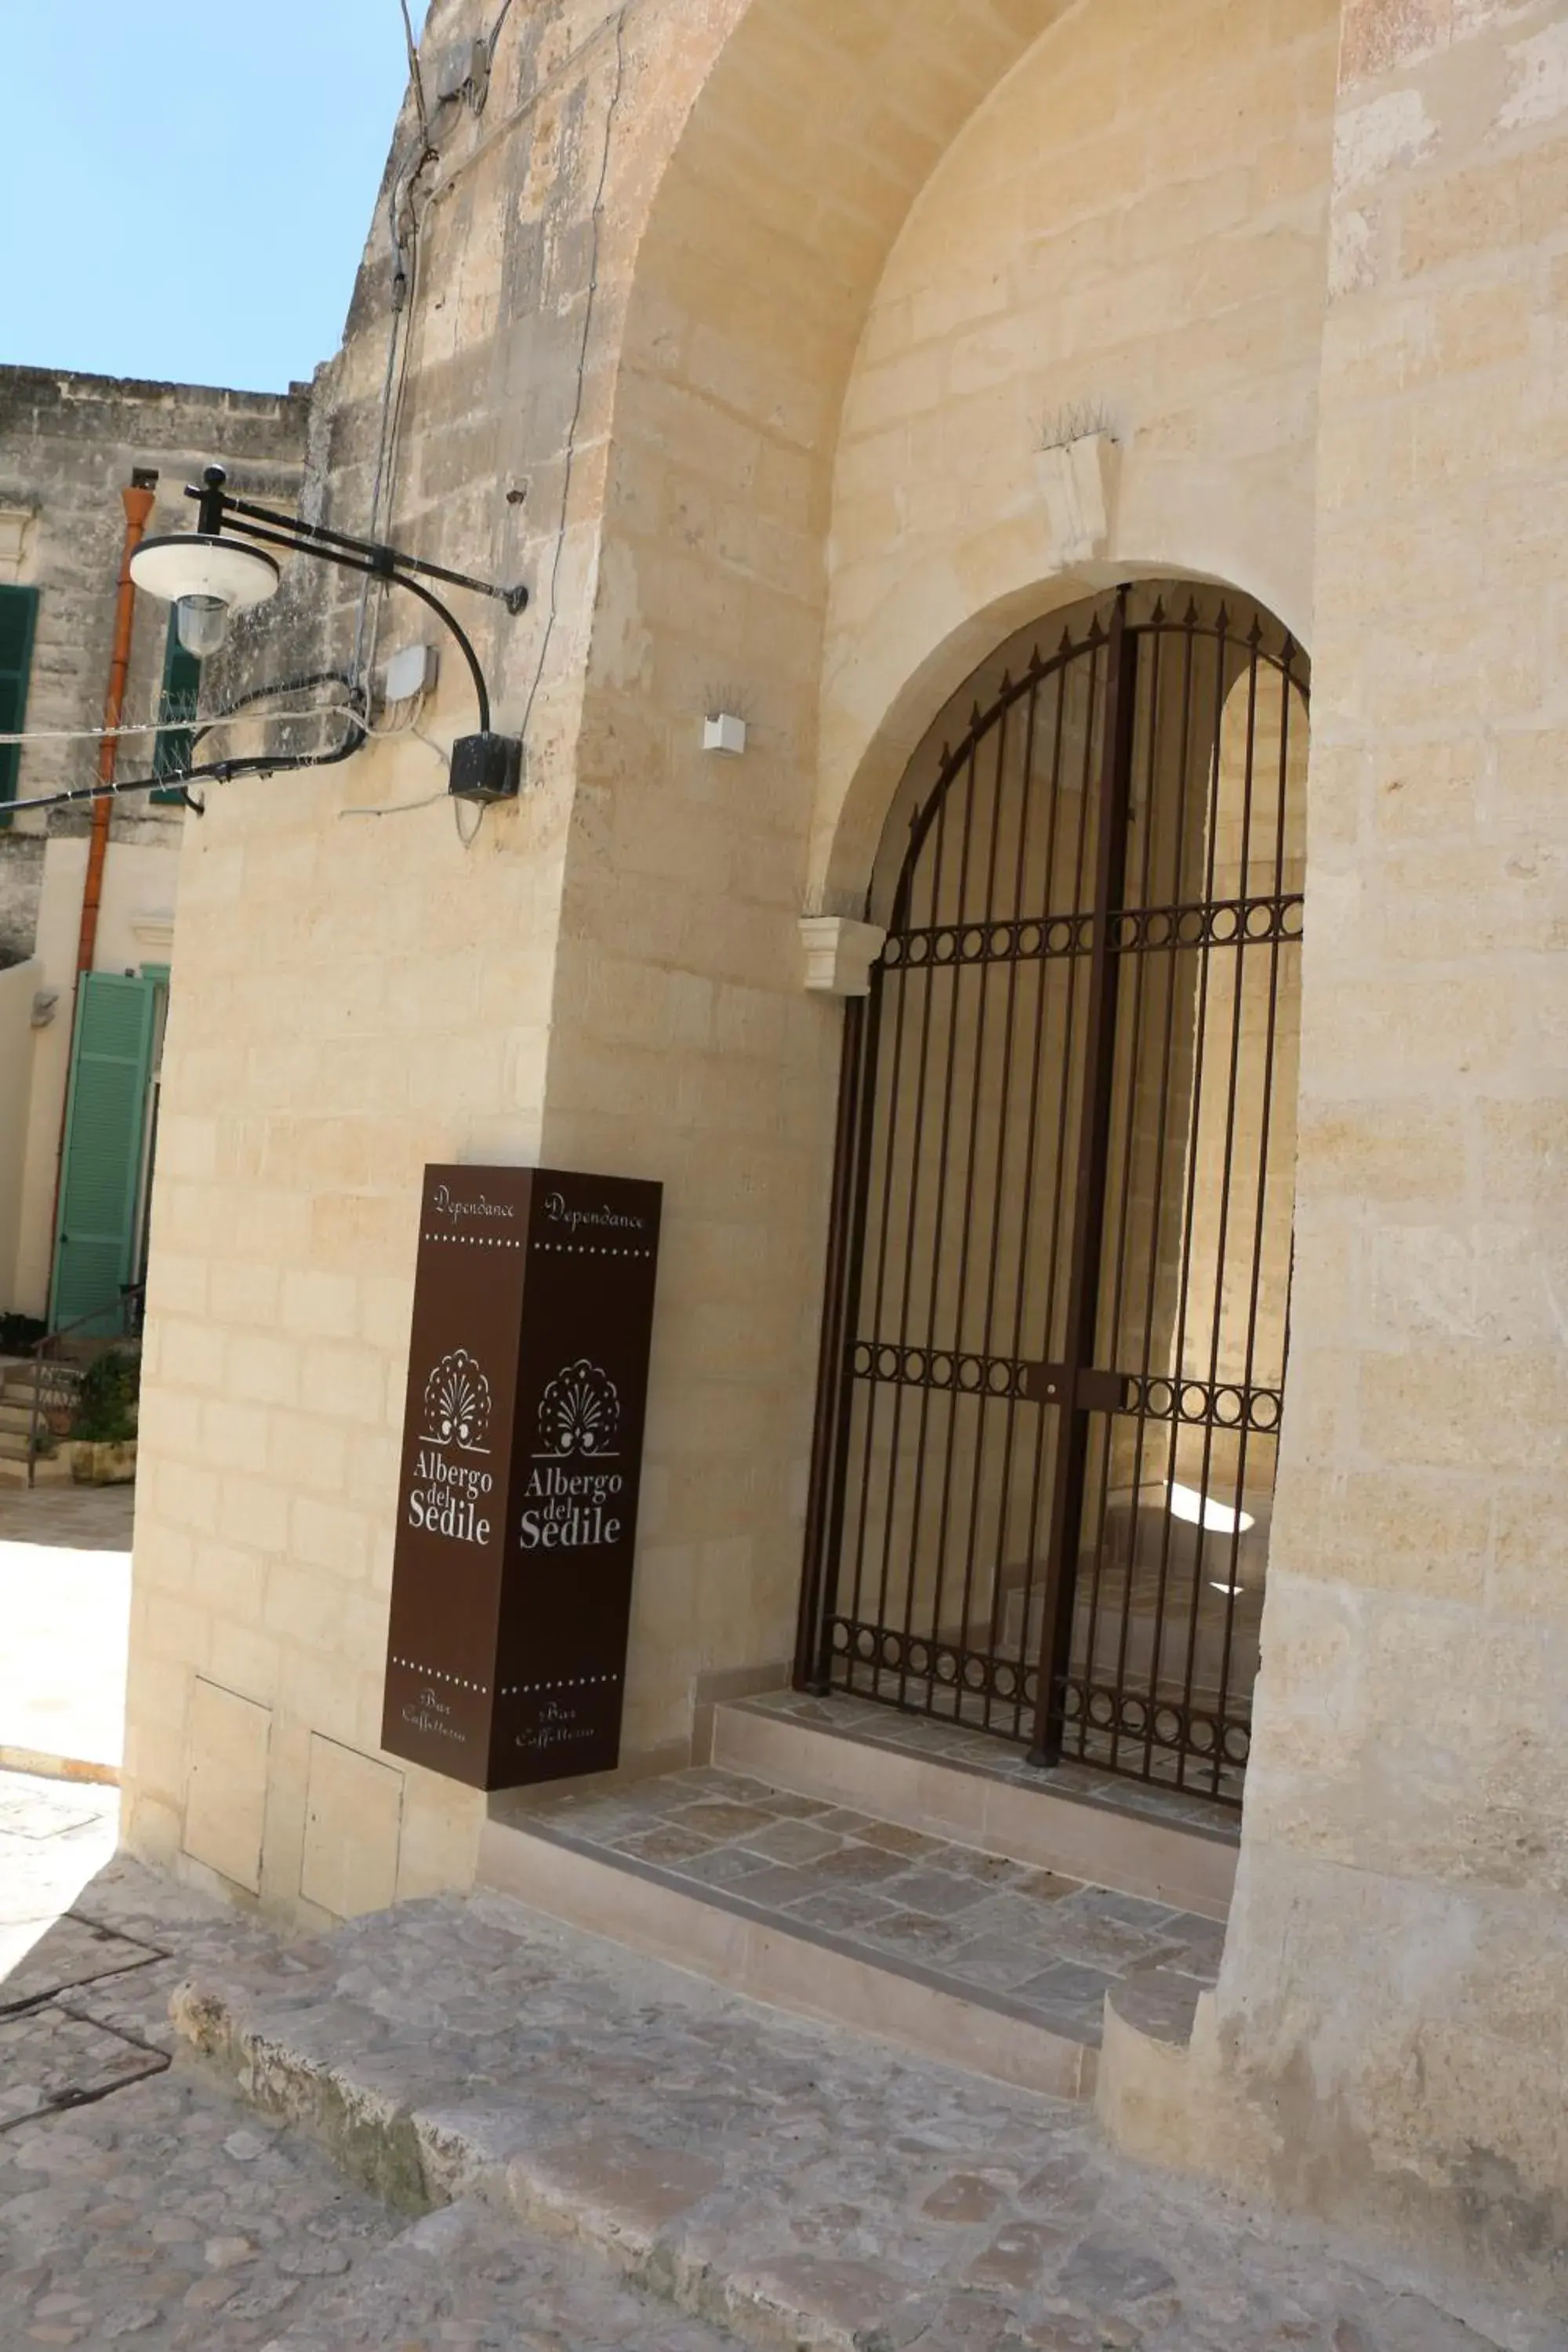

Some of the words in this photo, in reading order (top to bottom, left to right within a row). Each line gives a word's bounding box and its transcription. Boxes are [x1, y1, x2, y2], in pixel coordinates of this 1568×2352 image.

[434, 1184, 514, 1224] Dependance
[545, 1192, 643, 1232] Dependance
[413, 1450, 492, 1500] Albergo
[524, 1467, 622, 1503] Albergo
[427, 1483, 451, 1508] del
[543, 1497, 572, 1520] del
[408, 1490, 490, 1545] Sedile
[520, 1506, 620, 1548] Sedile
[419, 1687, 452, 1715] Bar
[539, 1701, 576, 1722] Bar
